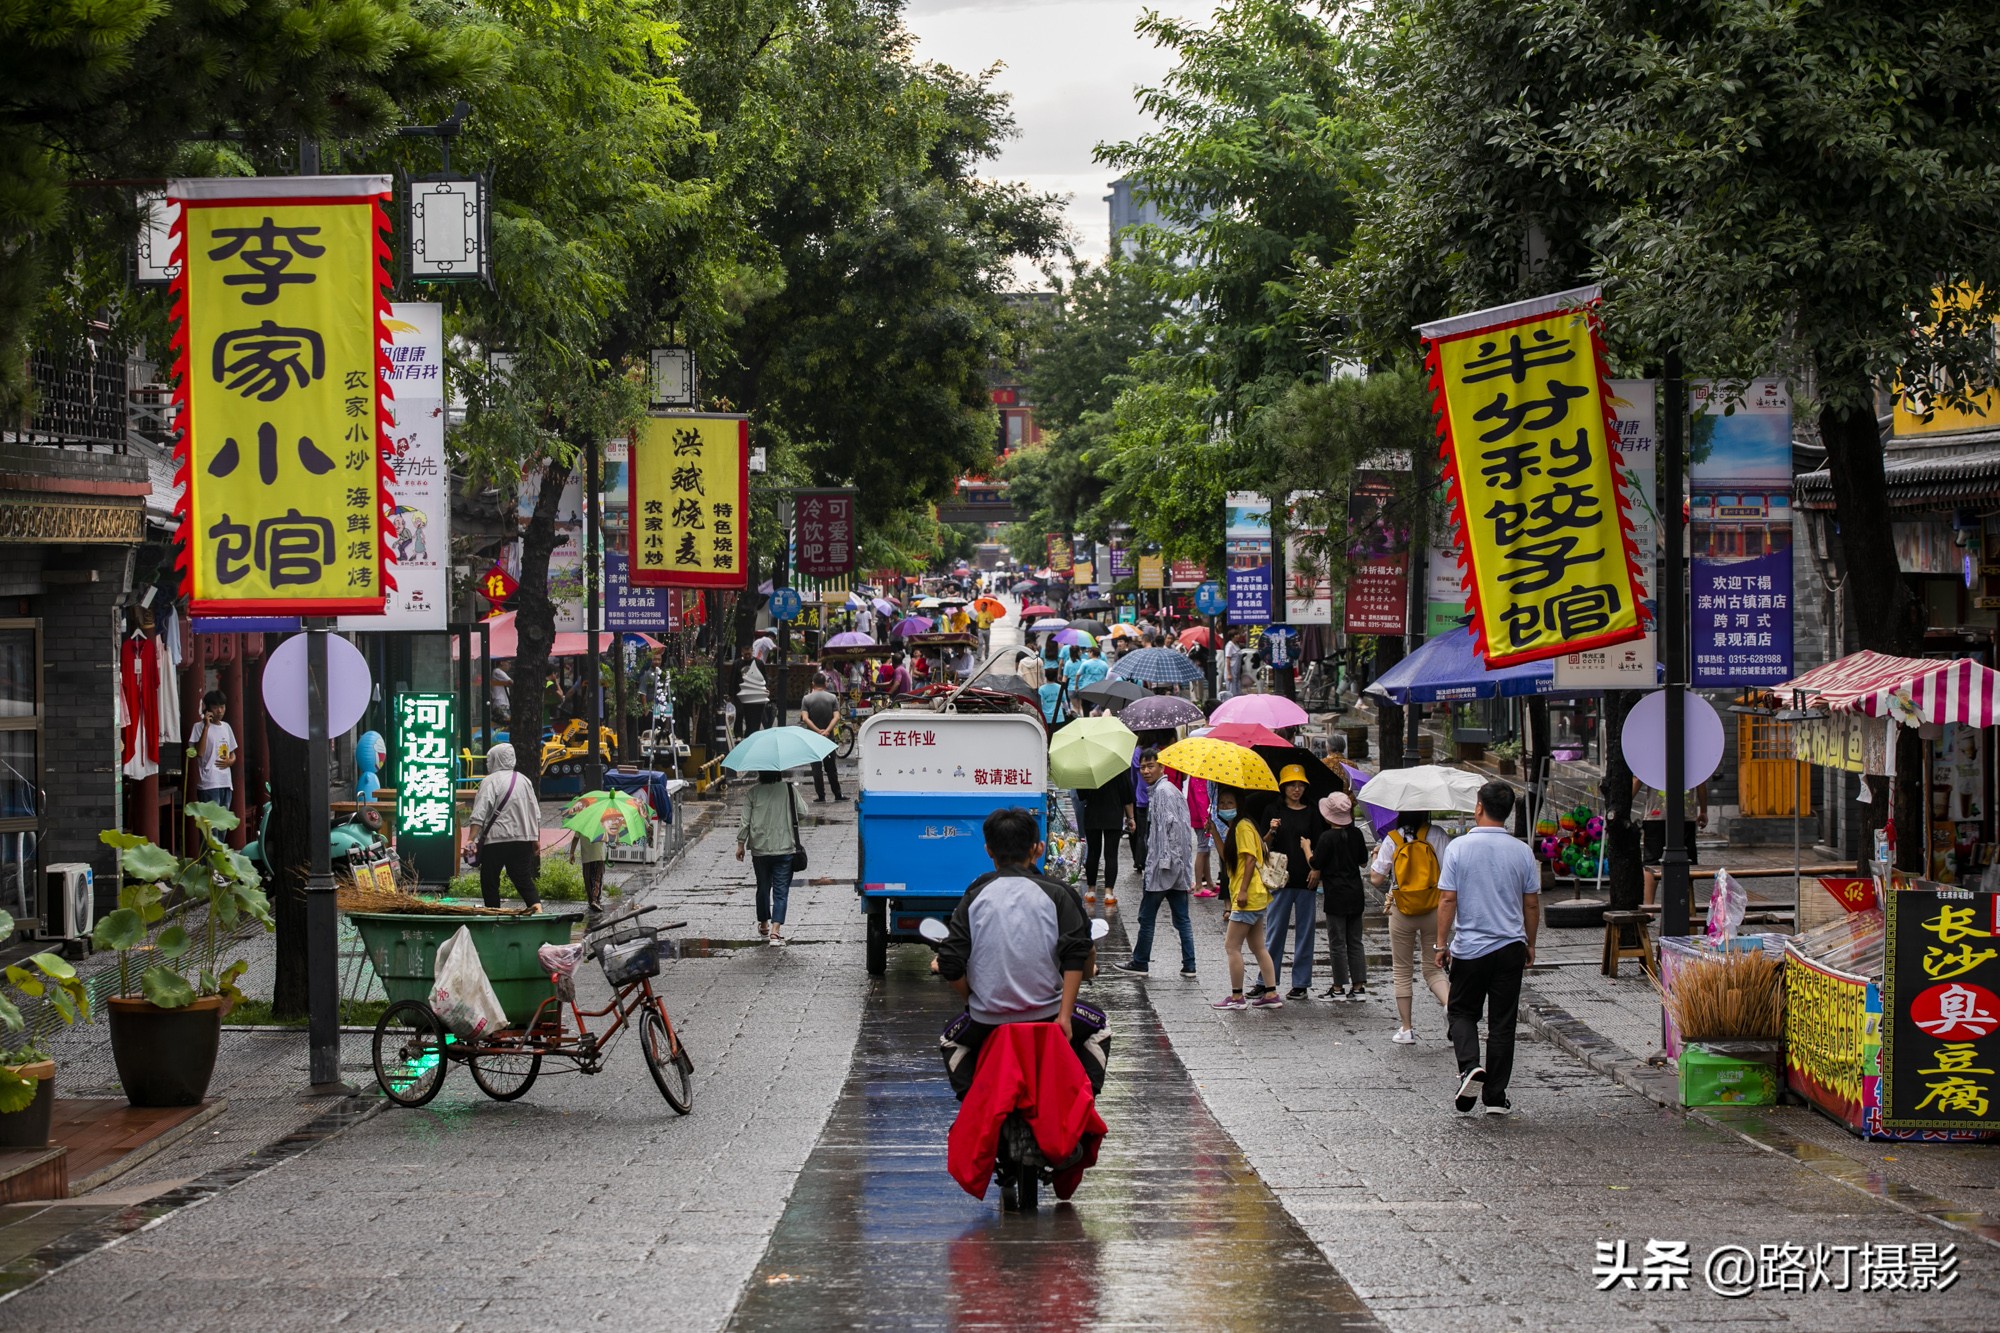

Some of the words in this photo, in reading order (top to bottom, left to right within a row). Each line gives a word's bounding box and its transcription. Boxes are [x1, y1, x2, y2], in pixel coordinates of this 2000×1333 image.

[207, 217, 337, 590] 李家小馆
[344, 371, 370, 471] 农家小炒
[1461, 329, 1621, 649] 半分利饺子馆
[346, 487, 373, 589] 海鲜烧烤
[644, 500, 664, 566] 农家小炒
[712, 502, 733, 569] 特色烧烤
[802, 498, 825, 564] 冷饮吧
[828, 499, 849, 563] 可爱雪
[618, 598, 655, 607] 景观酒店
[1698, 594, 1786, 609] 滦州古镇酒店
[1713, 576, 1771, 590] 欢迎下榻
[1713, 632, 1771, 646] 景观酒店
[403, 698, 451, 832] 河边烧烤
[878, 730, 936, 747] 正在作业
[974, 768, 1033, 785] 敬请避让
[1914, 904, 1998, 1118] 长沙臭豆腐
